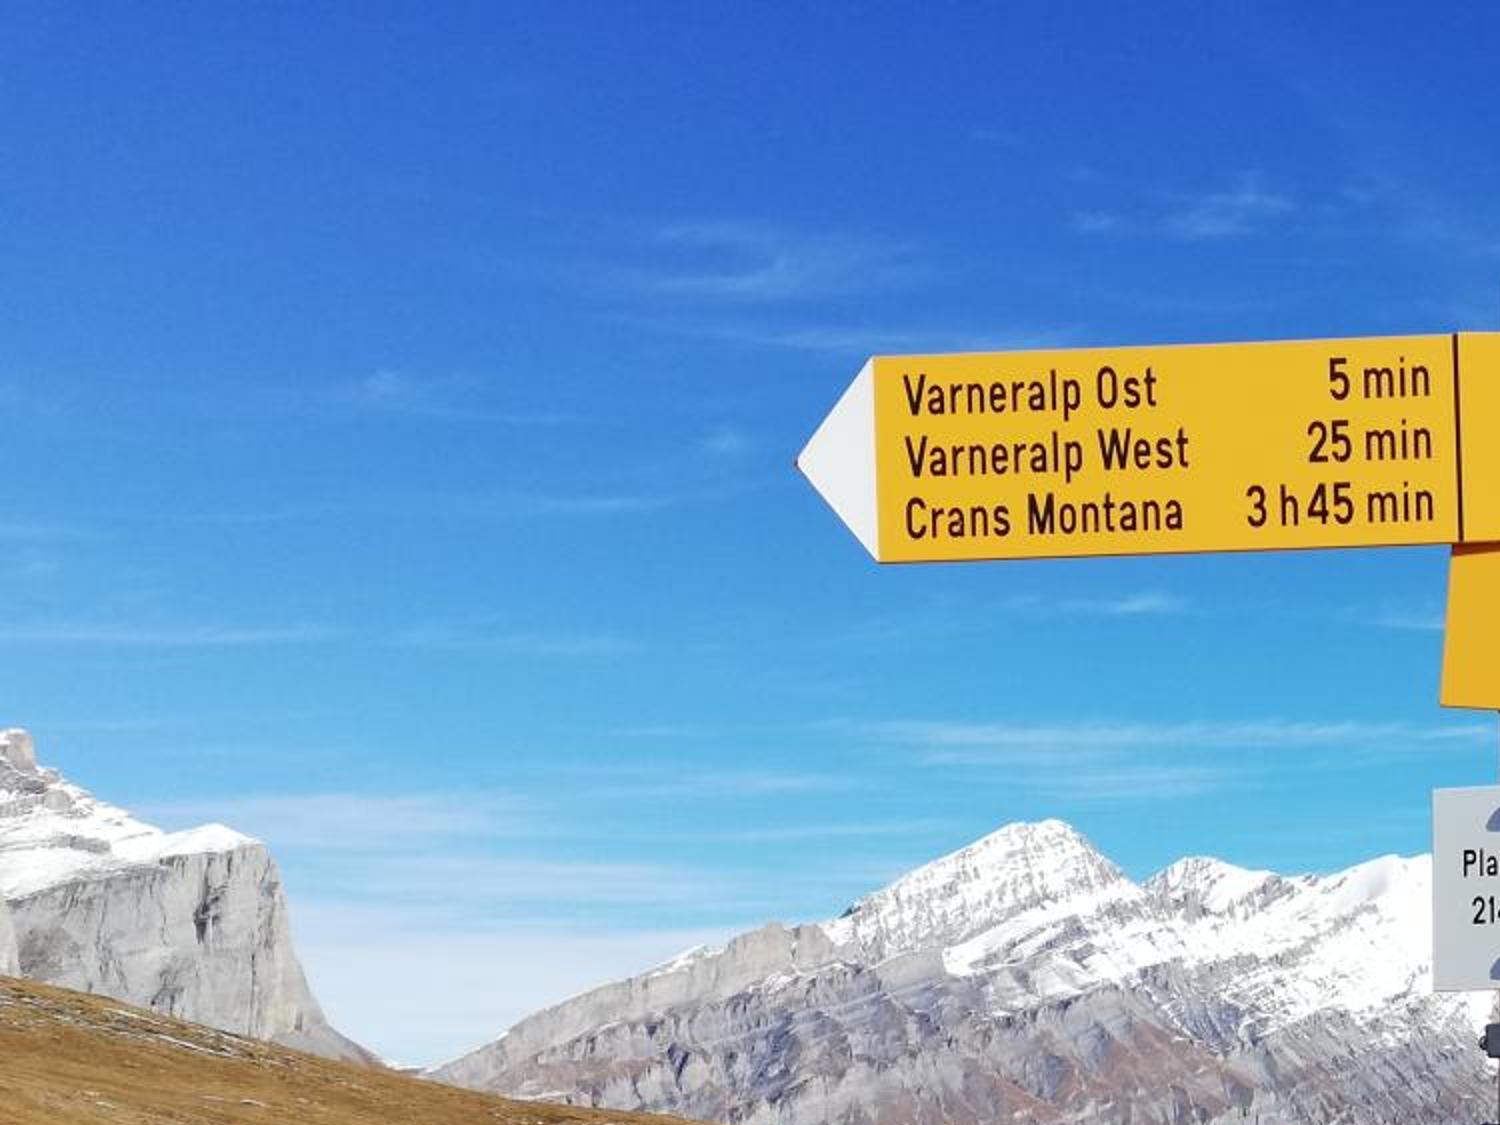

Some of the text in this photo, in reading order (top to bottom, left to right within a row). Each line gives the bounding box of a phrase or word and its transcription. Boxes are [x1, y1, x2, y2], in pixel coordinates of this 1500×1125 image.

[903, 356, 1430, 421] Varneralp Ost 5 min
[904, 418, 1432, 482] Varneralp West 25 min
[905, 481, 1434, 540] Crans Montana 3 h 45 min
